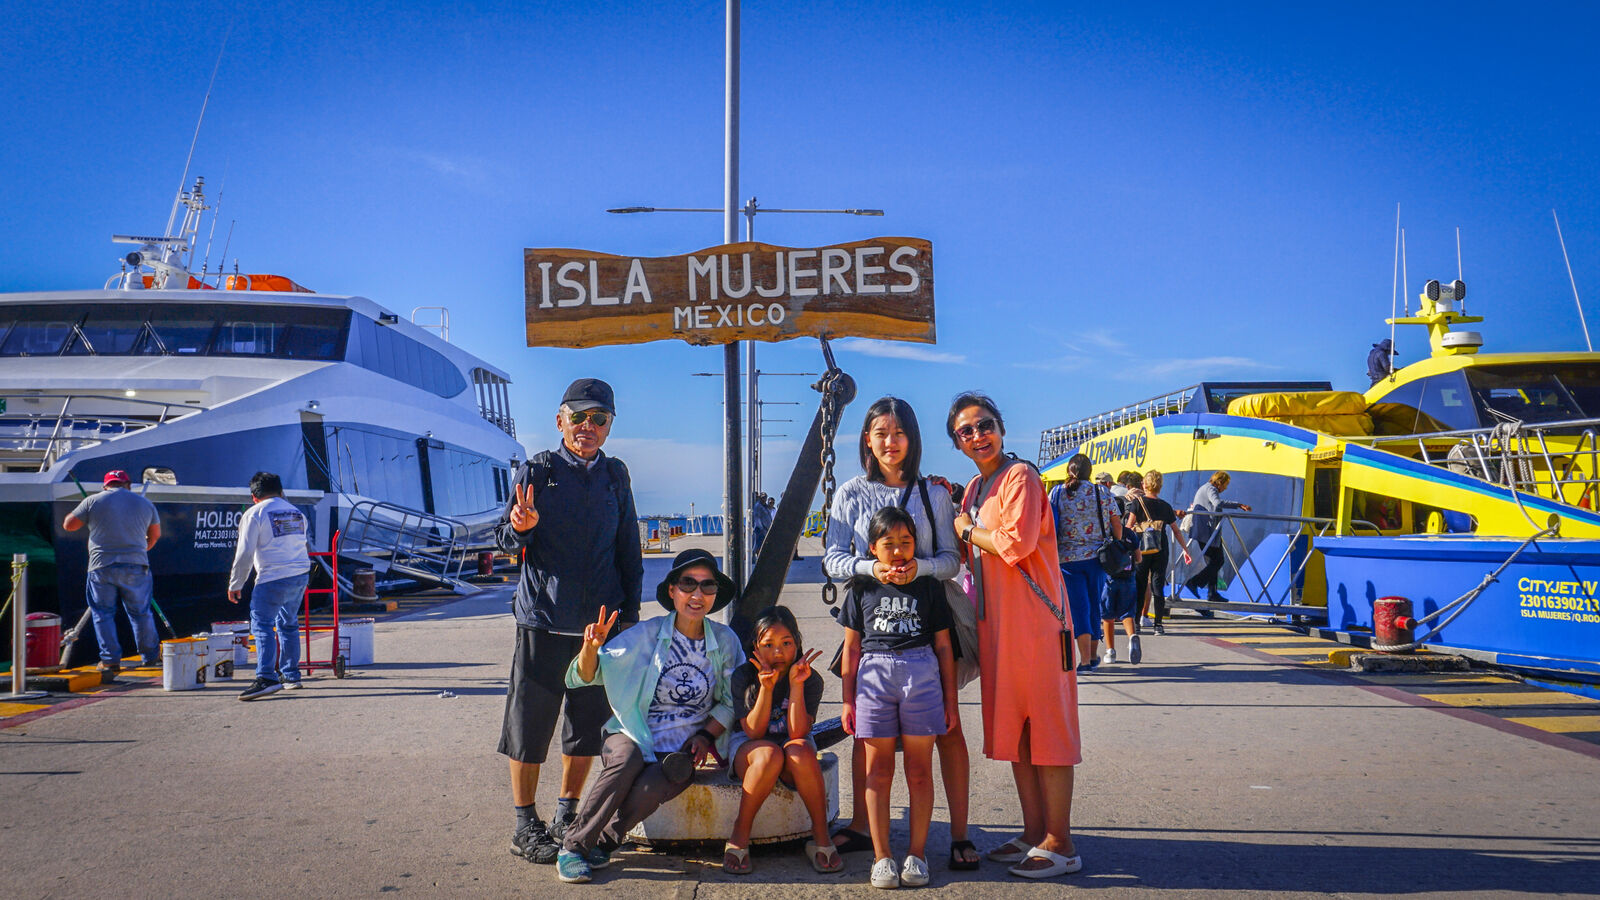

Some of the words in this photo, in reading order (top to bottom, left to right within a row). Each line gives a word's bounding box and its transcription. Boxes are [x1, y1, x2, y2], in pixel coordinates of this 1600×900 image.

[538, 258, 652, 309] ISLA
[688, 245, 920, 300] MUJERES
[673, 301, 785, 330] MÉXICO
[1518, 577, 1580, 594] CITYJET
[1582, 581, 1598, 595] IV
[1520, 594, 1600, 612] 23016390213
[1521, 609, 1537, 618] ISLA
[1537, 610, 1571, 620] MUJERES
